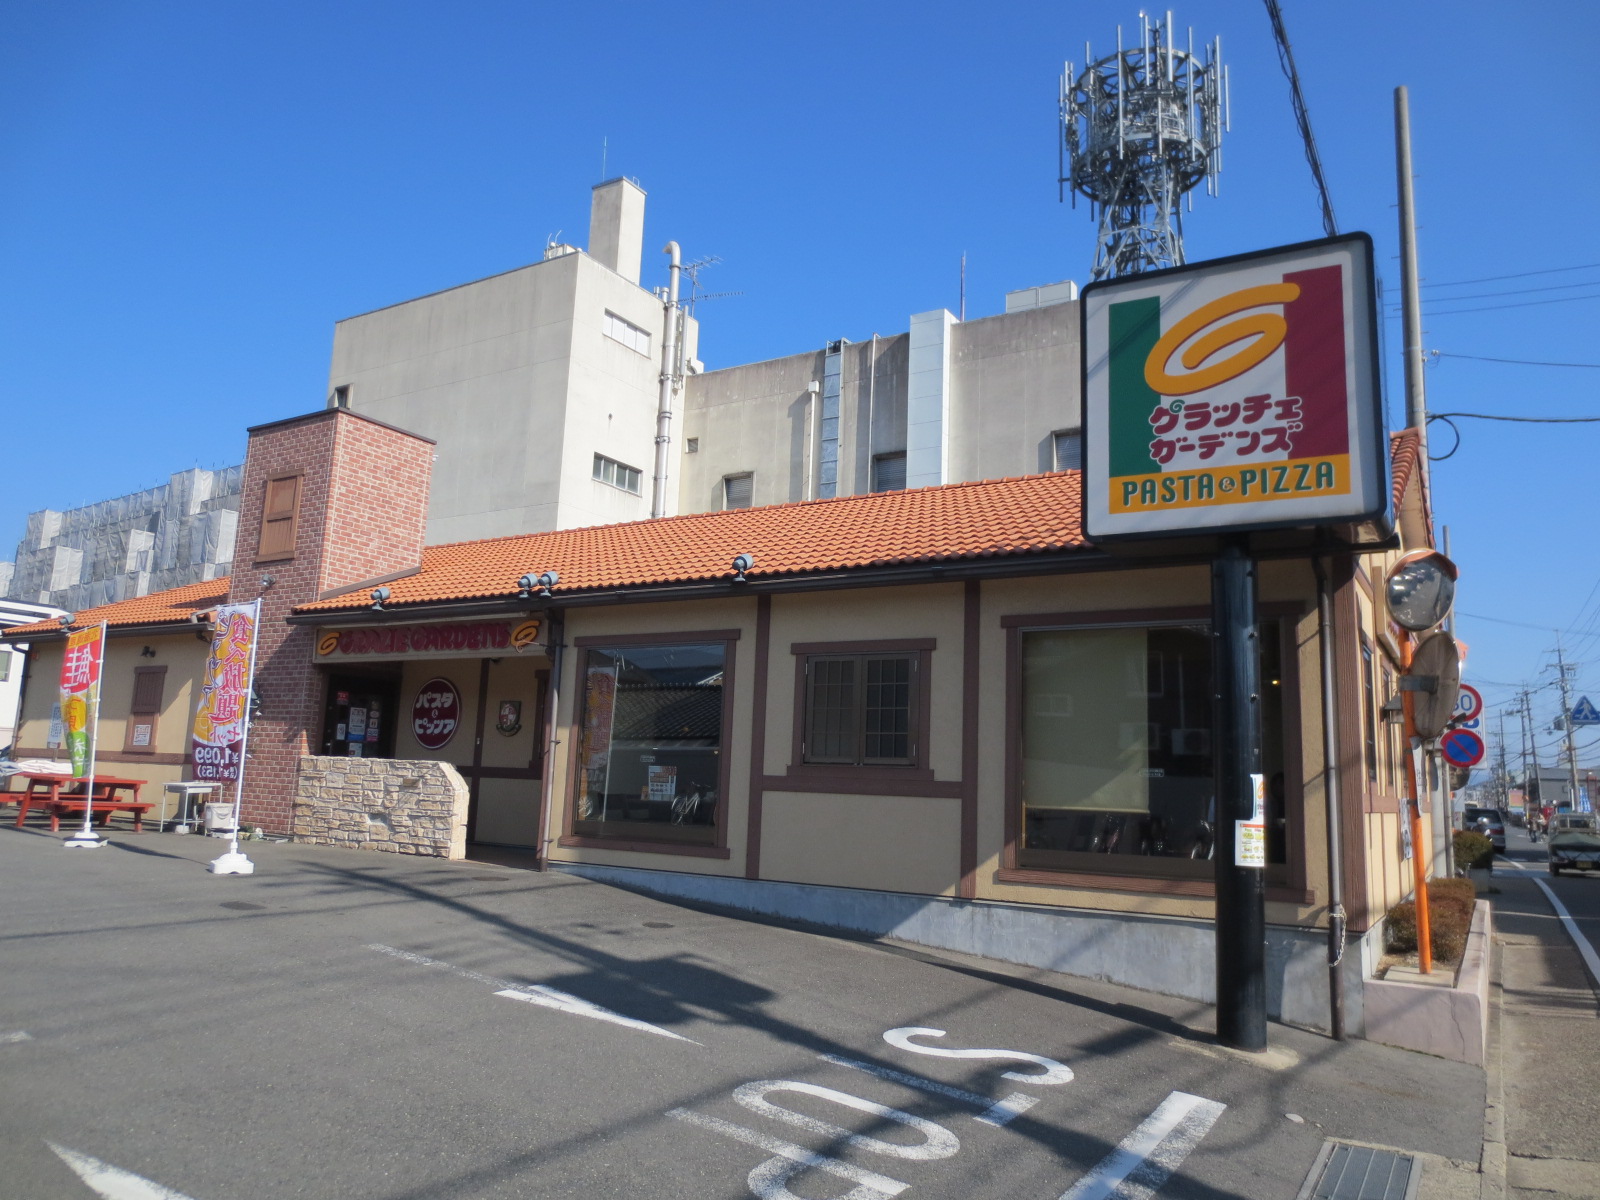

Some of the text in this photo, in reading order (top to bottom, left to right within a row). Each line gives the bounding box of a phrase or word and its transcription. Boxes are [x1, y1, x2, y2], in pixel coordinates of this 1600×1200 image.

[1149, 393, 1302, 435] グラッチェ
[1149, 422, 1303, 464] ガーデンズ
[1122, 461, 1335, 507] PASTA & PIZZA
[339, 621, 512, 654] GRAZIE GARDENS
[415, 691, 454, 709] パスタ
